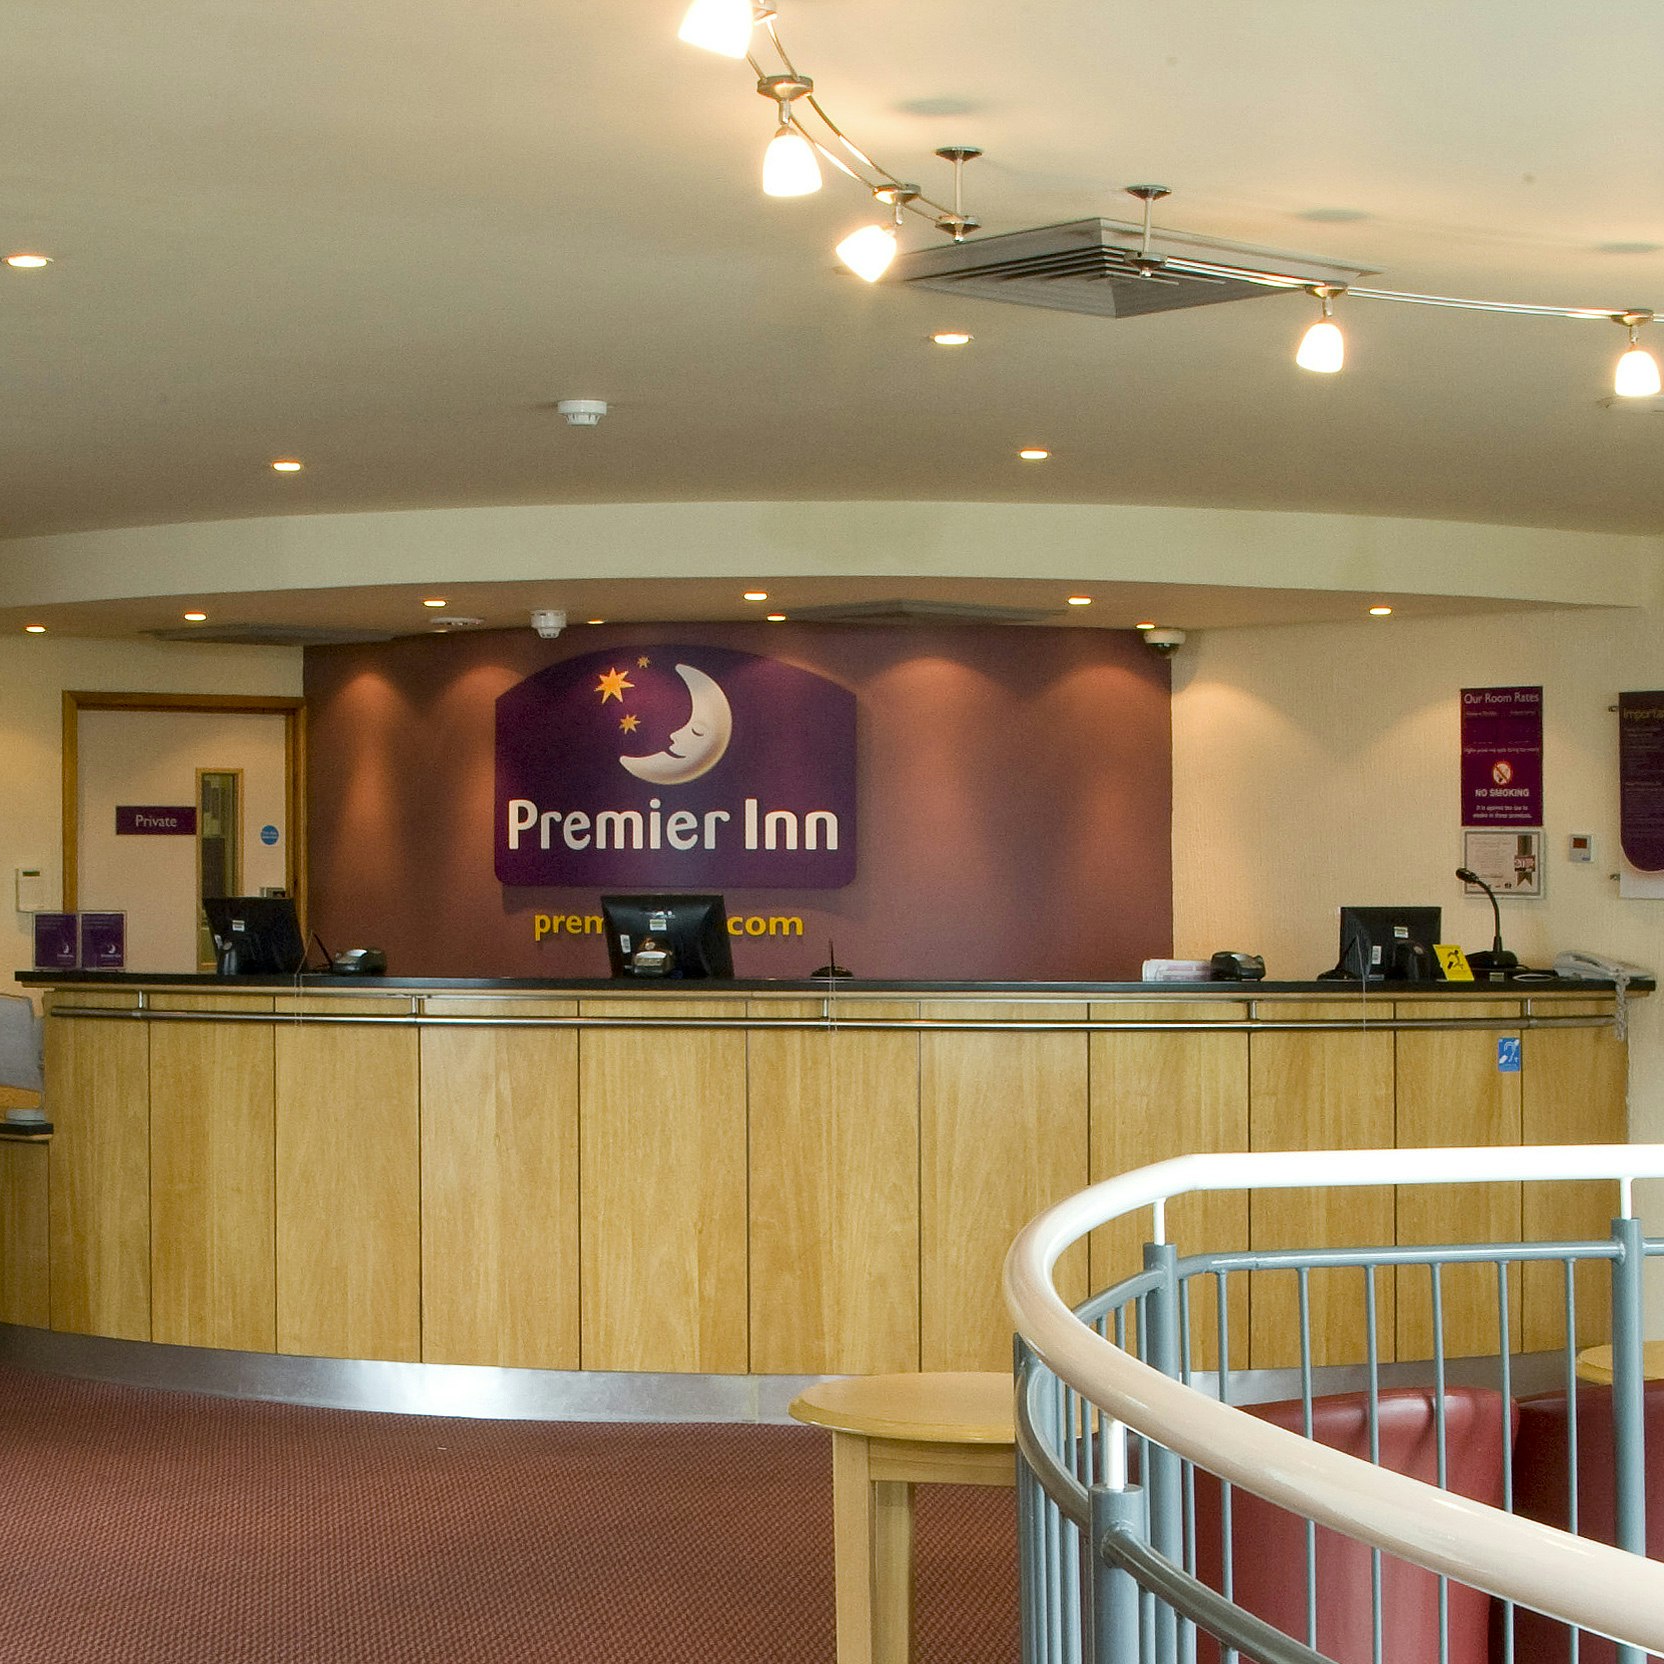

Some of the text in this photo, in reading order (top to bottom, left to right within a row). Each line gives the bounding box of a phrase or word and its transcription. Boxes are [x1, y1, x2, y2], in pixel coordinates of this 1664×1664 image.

[1464, 691, 1540, 704] Our Room Rates
[1475, 788, 1530, 798] NO SMOKING
[135, 814, 178, 828] Private
[508, 797, 839, 851] Premier Inn
